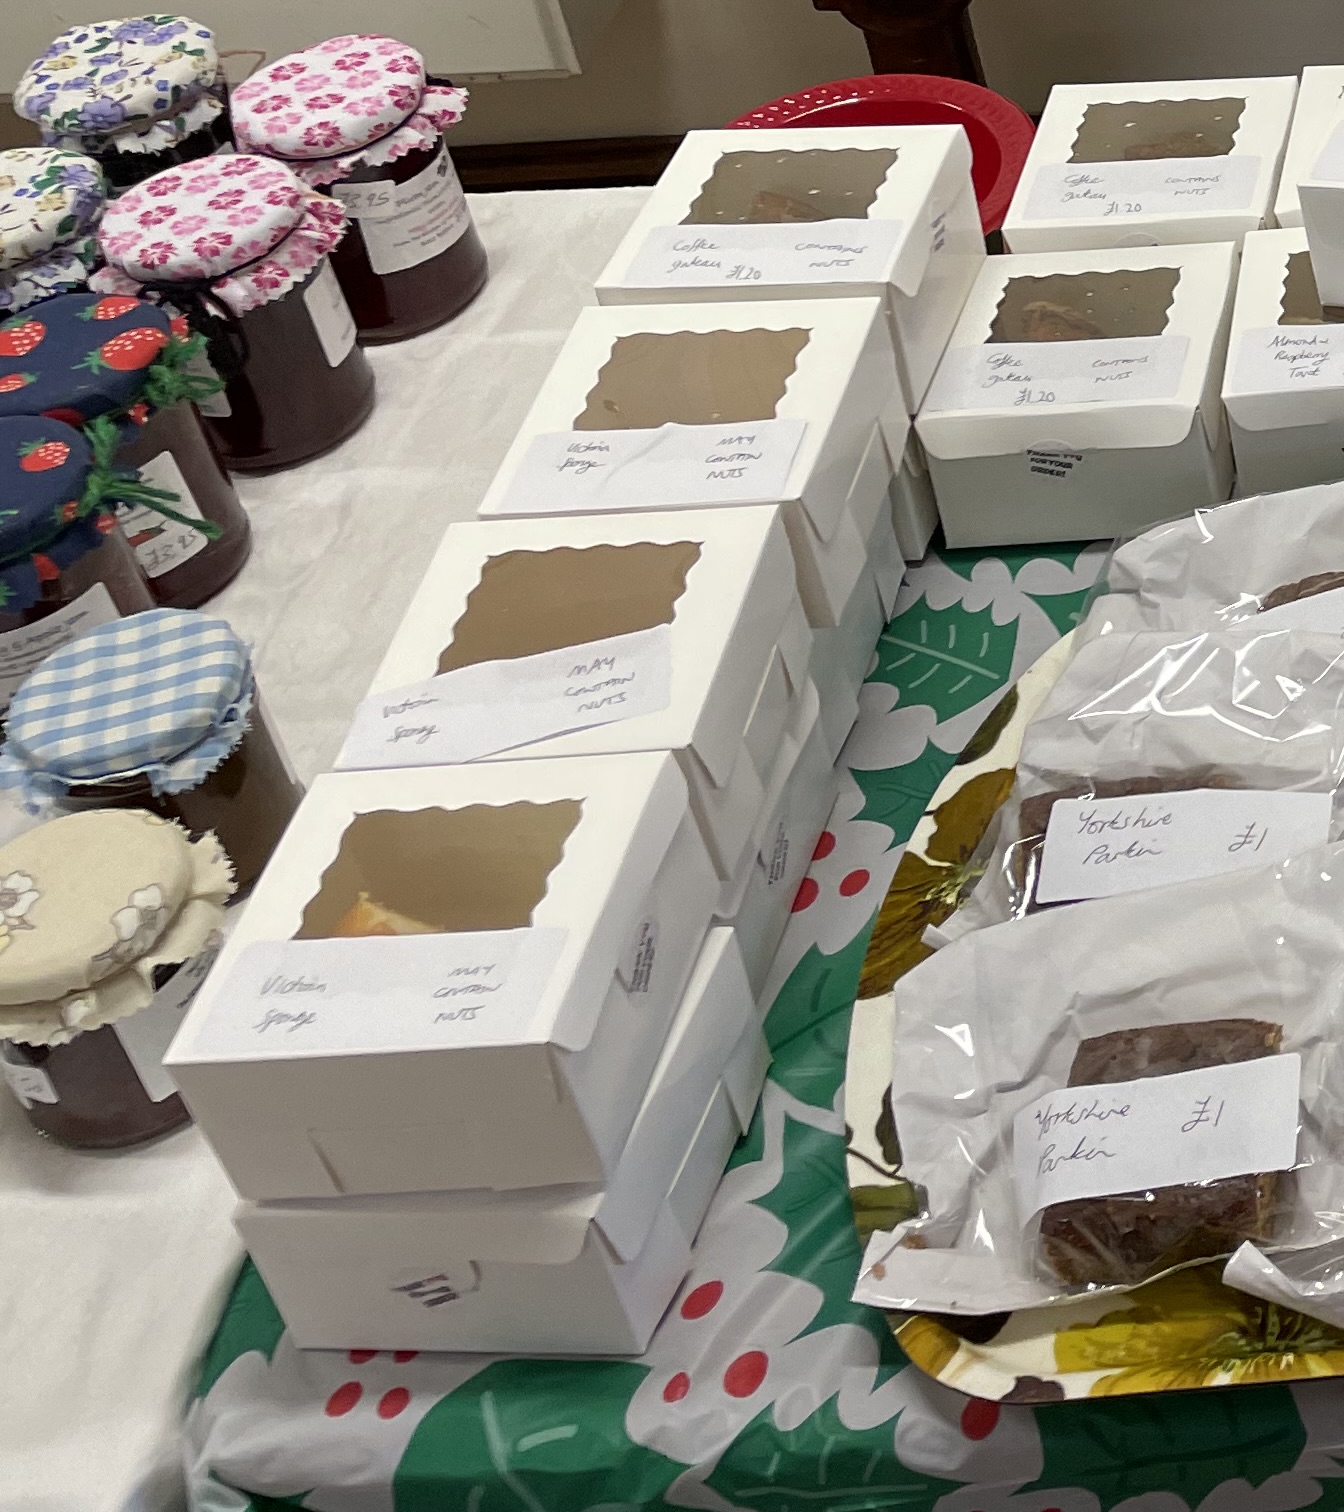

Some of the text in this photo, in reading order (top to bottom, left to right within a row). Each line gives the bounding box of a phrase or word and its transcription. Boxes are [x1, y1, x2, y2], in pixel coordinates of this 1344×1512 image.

[566, 656, 616, 678] MAY
[576, 691, 628, 713] NUTS
[1076, 808, 1270, 854] Yorkshire £1
[1082, 841, 1163, 866] Parkin
[1034, 1097, 1223, 1137] Yorkshire £1
[1036, 1136, 1117, 1178] Parkin
